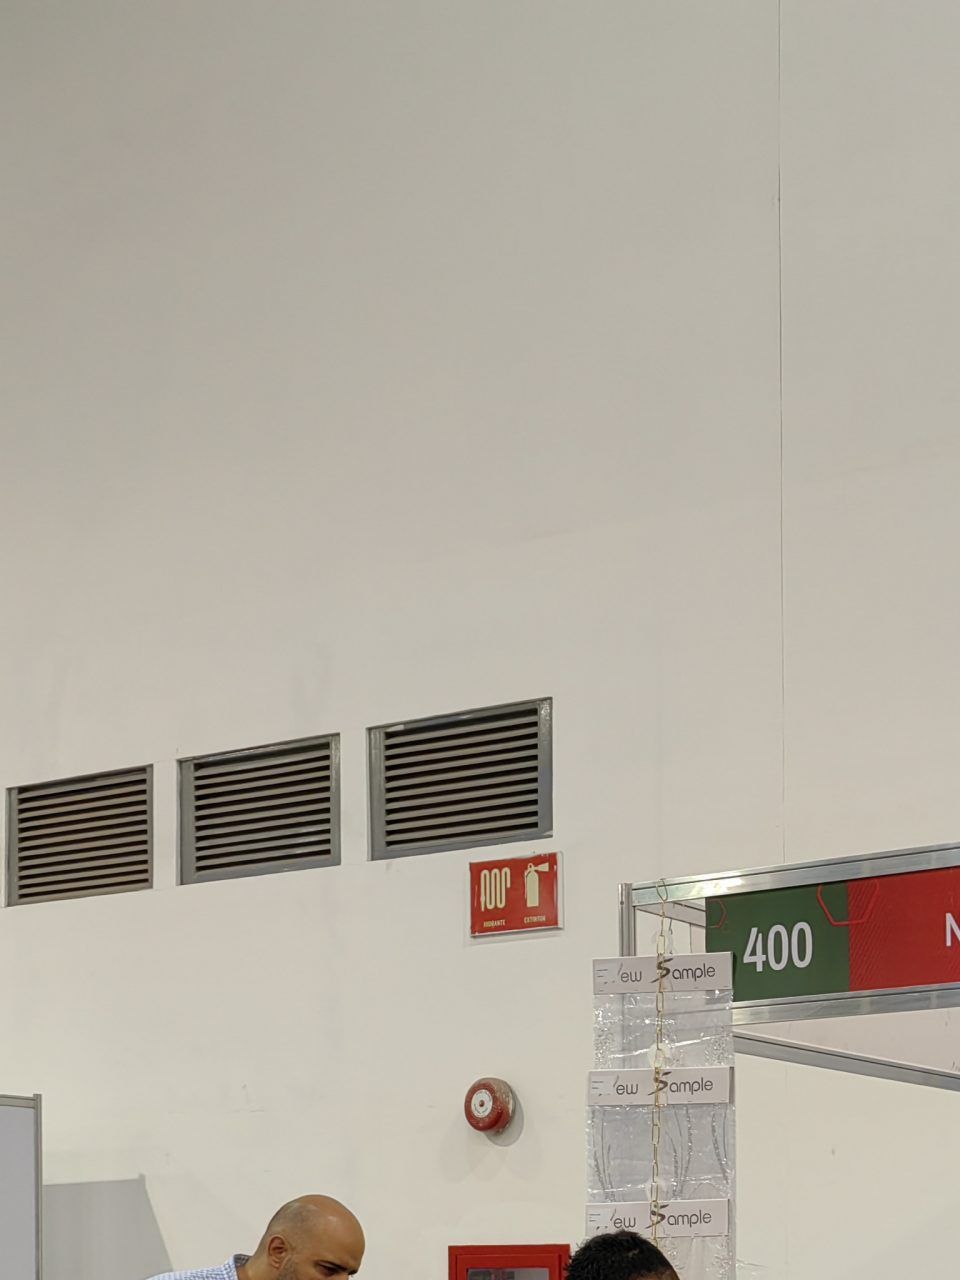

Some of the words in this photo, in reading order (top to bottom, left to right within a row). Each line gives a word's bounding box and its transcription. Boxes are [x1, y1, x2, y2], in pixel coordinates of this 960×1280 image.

[743, 921, 813, 972] 400
[650, 958, 716, 983] Sample
[648, 1071, 714, 1096] Sample
[645, 1204, 712, 1229] Sample
